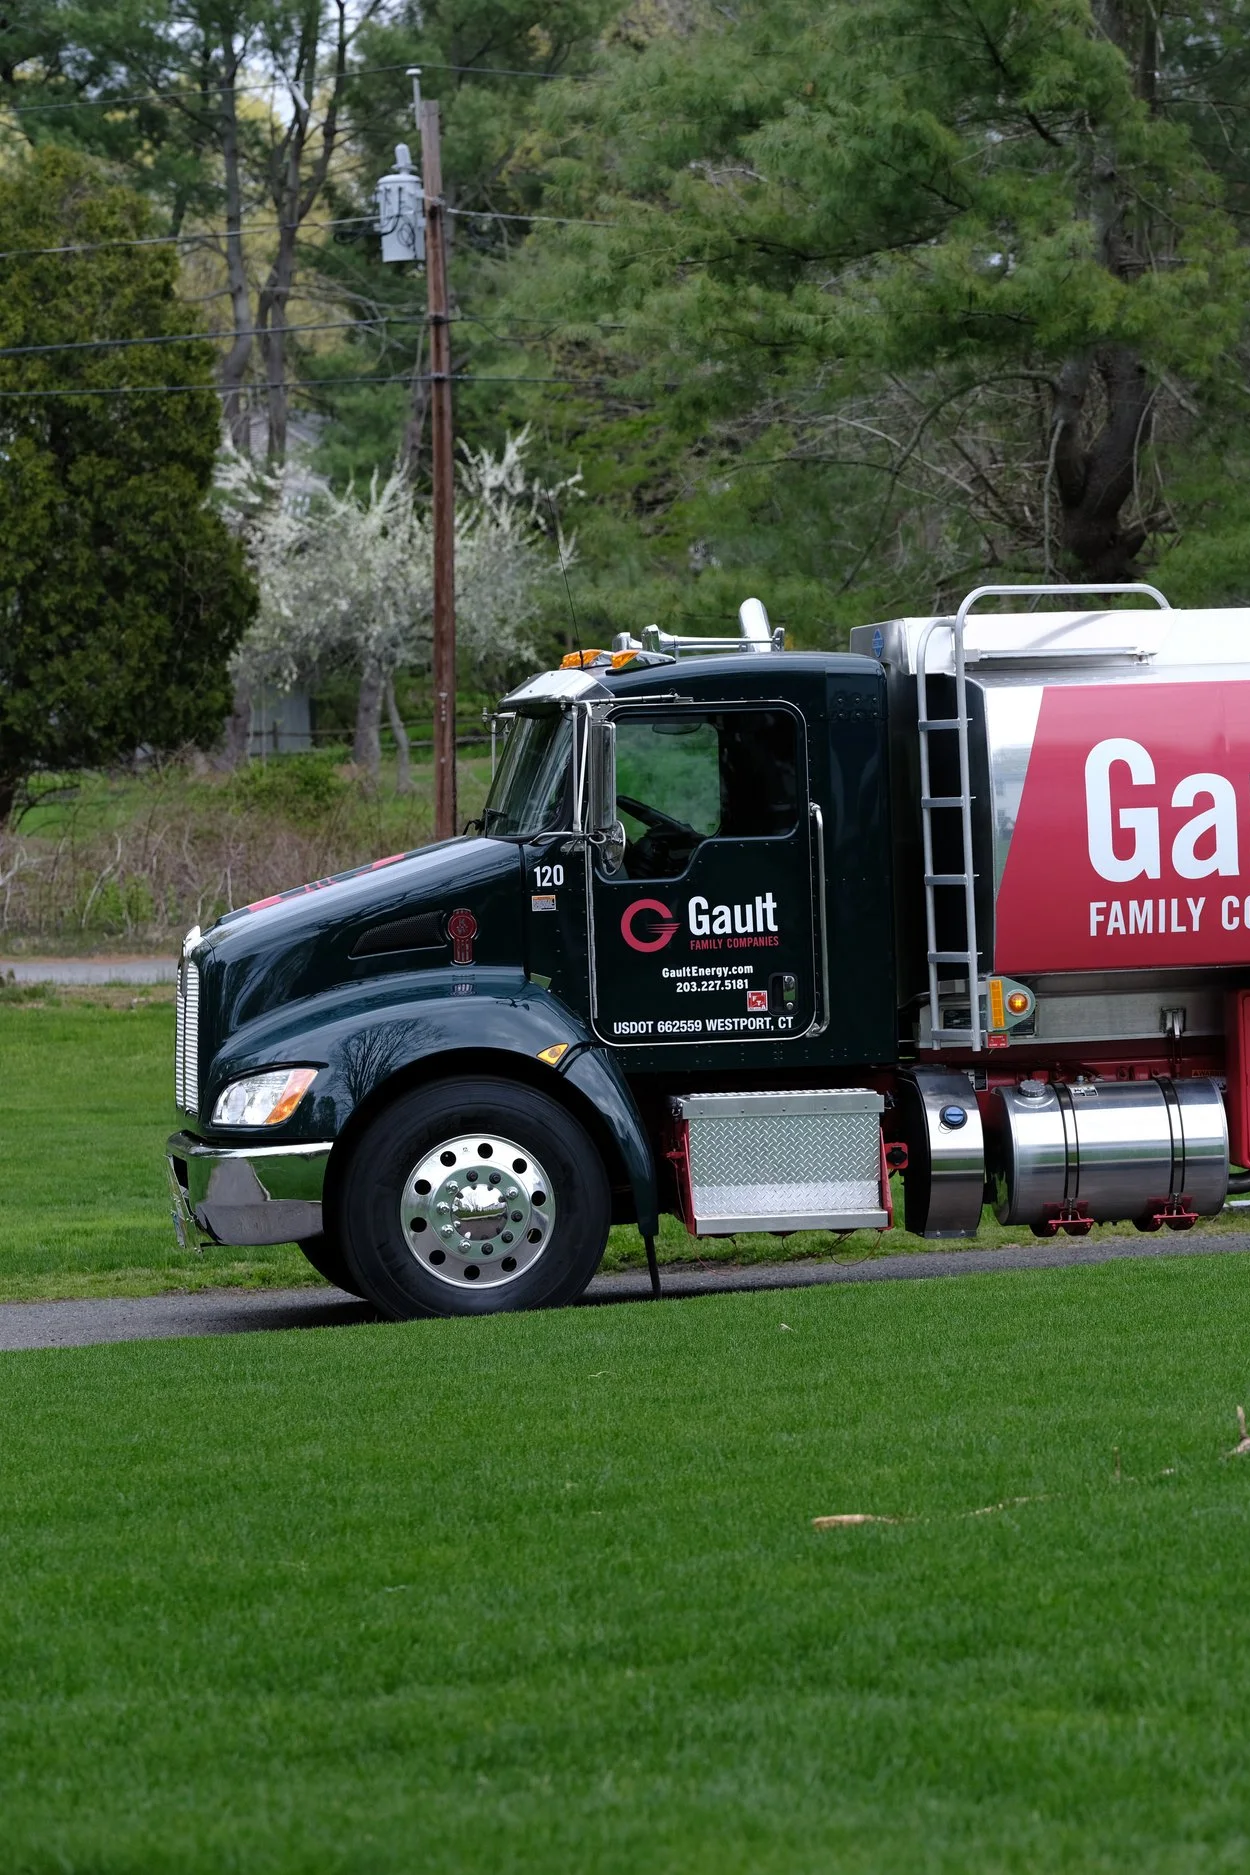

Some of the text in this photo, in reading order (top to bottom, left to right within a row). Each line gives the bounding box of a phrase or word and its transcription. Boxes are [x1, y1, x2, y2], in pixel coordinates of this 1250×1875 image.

[533, 865, 564, 887] 120
[688, 892, 779, 936] Gault
[1089, 897, 1206, 937] FAMILY
[690, 936, 779, 950] FAMILY COMPANIES
[662, 964, 754, 979] GaultEnergy.com
[676, 979, 749, 993] 203.227.5181
[613, 1016, 793, 1034] USDOT 662559 WESTPORT, CT
